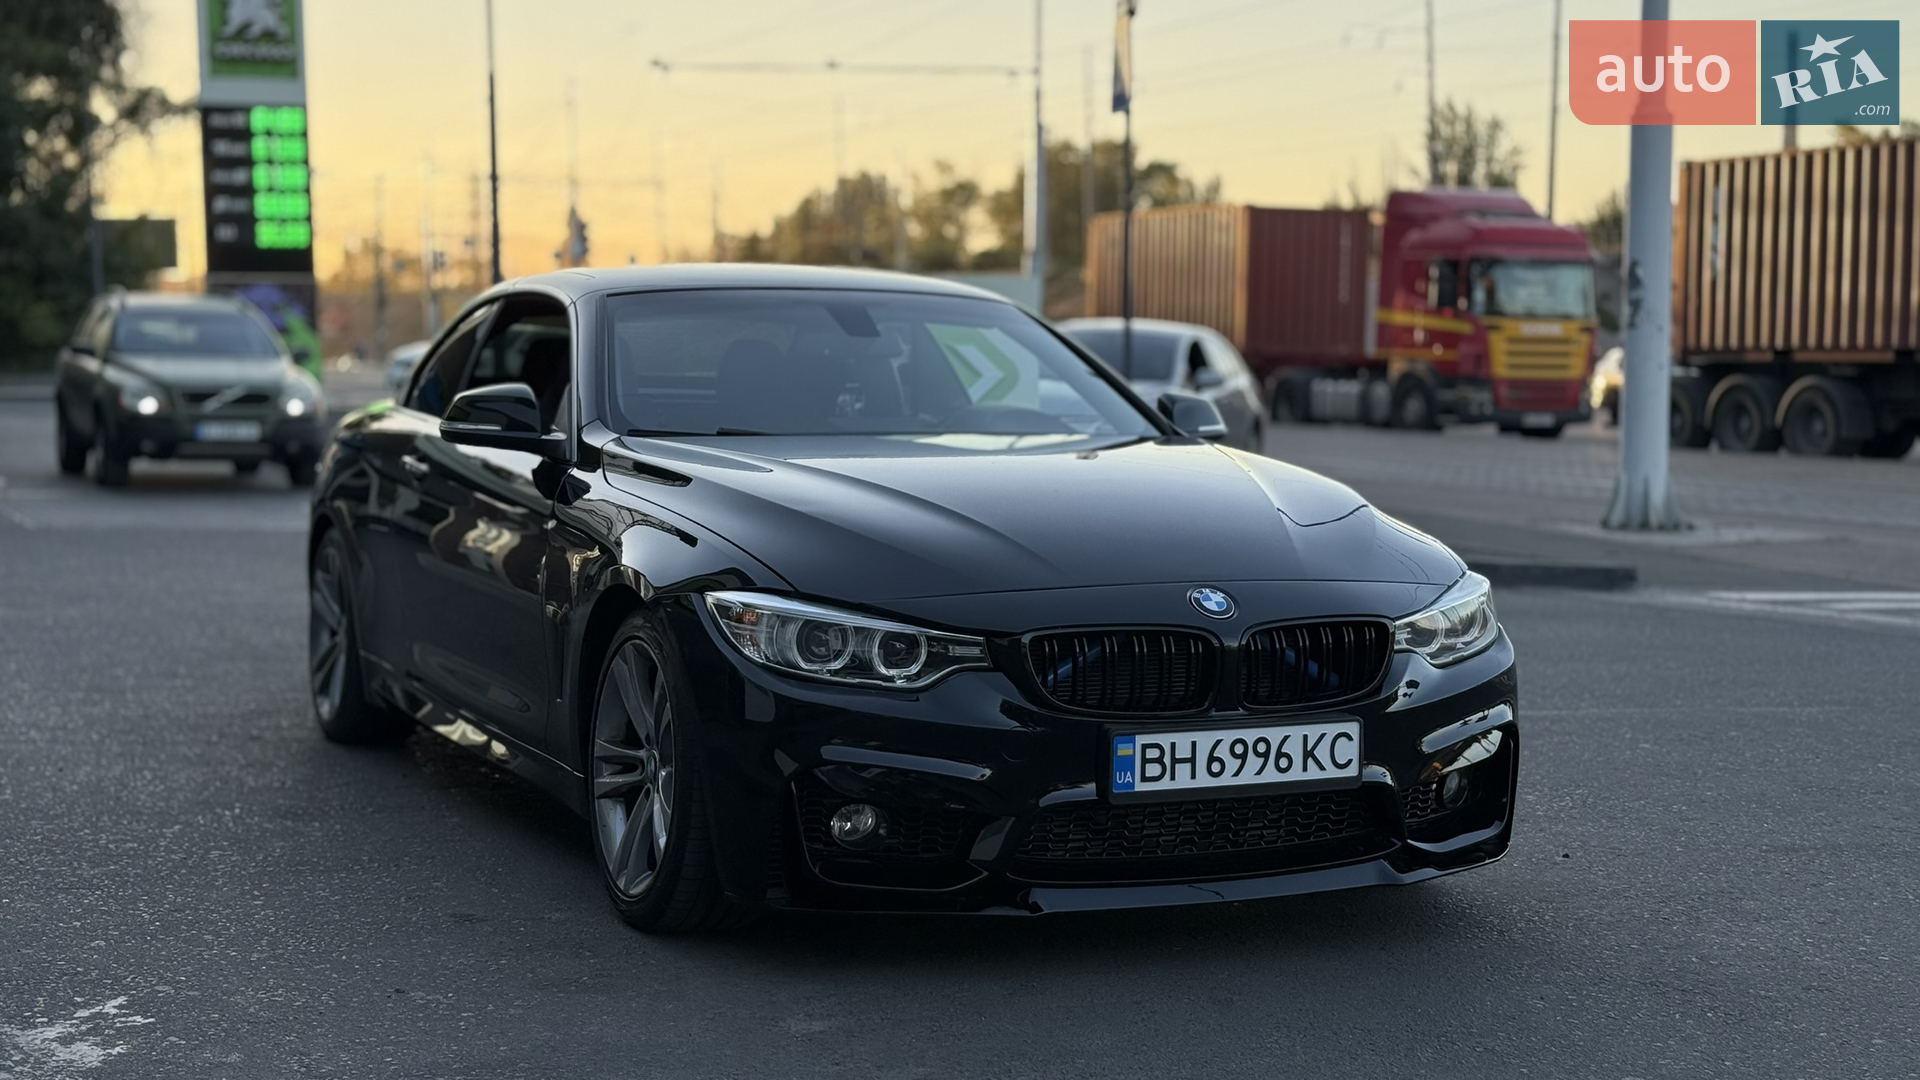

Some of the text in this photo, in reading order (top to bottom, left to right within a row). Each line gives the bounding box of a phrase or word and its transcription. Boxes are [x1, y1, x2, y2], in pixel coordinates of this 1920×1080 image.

[1140, 731, 1354, 783] BH 6996 KC
[1116, 771, 1133, 784] UA
